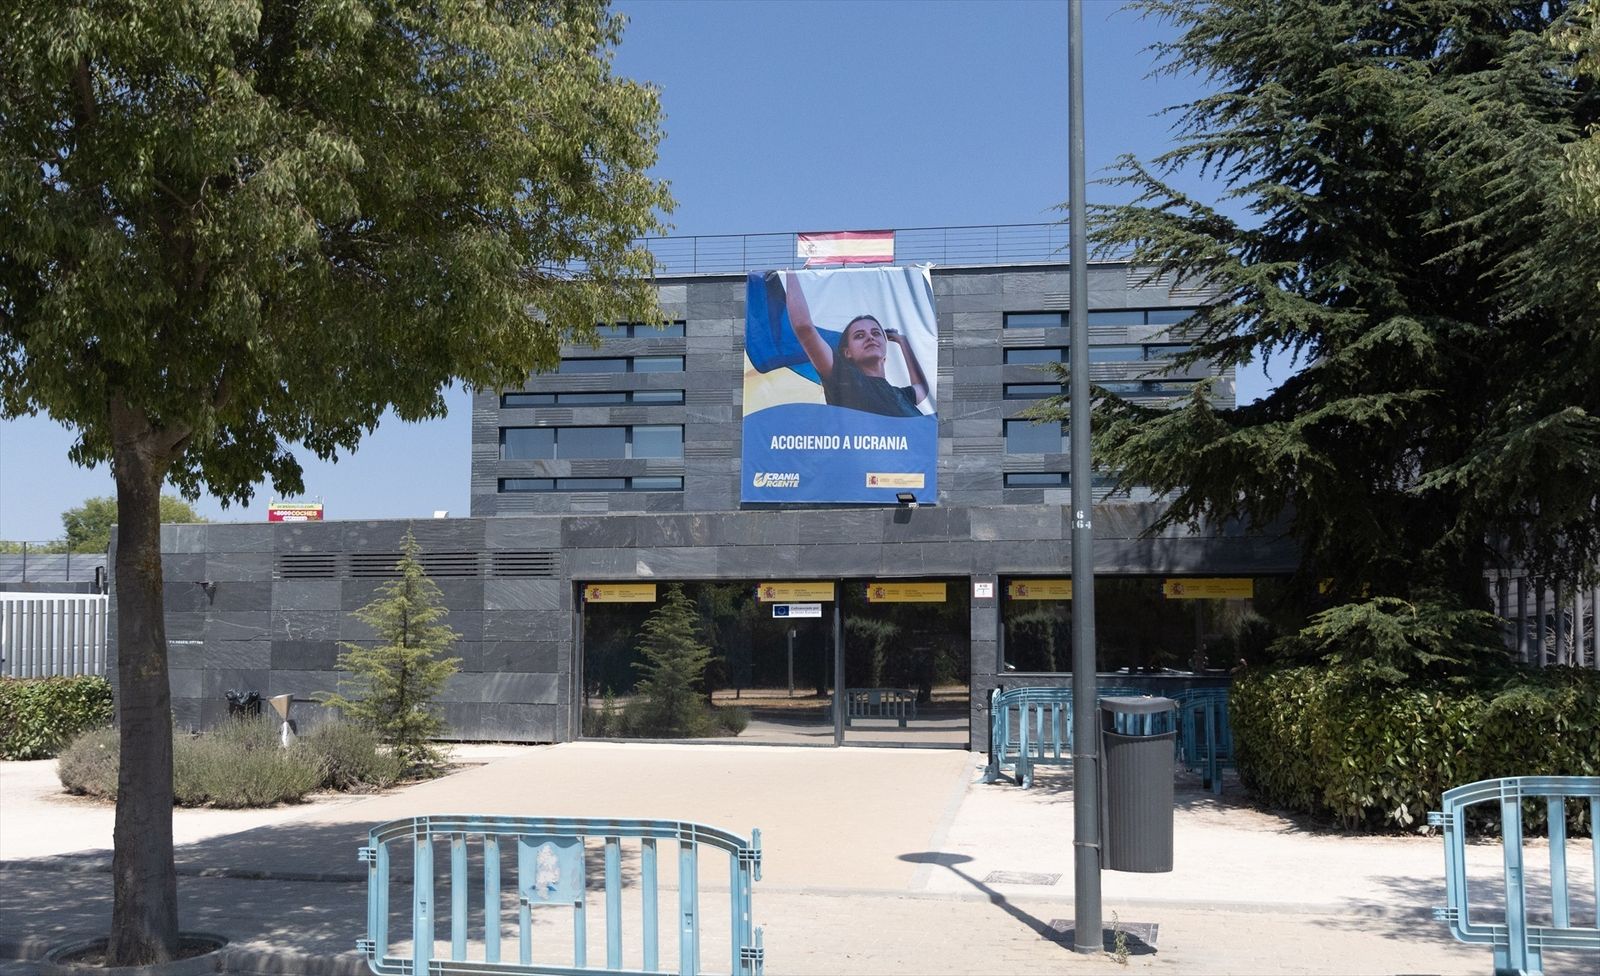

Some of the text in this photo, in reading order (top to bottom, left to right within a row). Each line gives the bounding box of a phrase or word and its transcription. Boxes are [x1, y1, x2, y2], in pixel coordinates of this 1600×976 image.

[770, 435, 908, 450] ACOGIENDO A UCRANIA
[1076, 510, 1084, 519] 6
